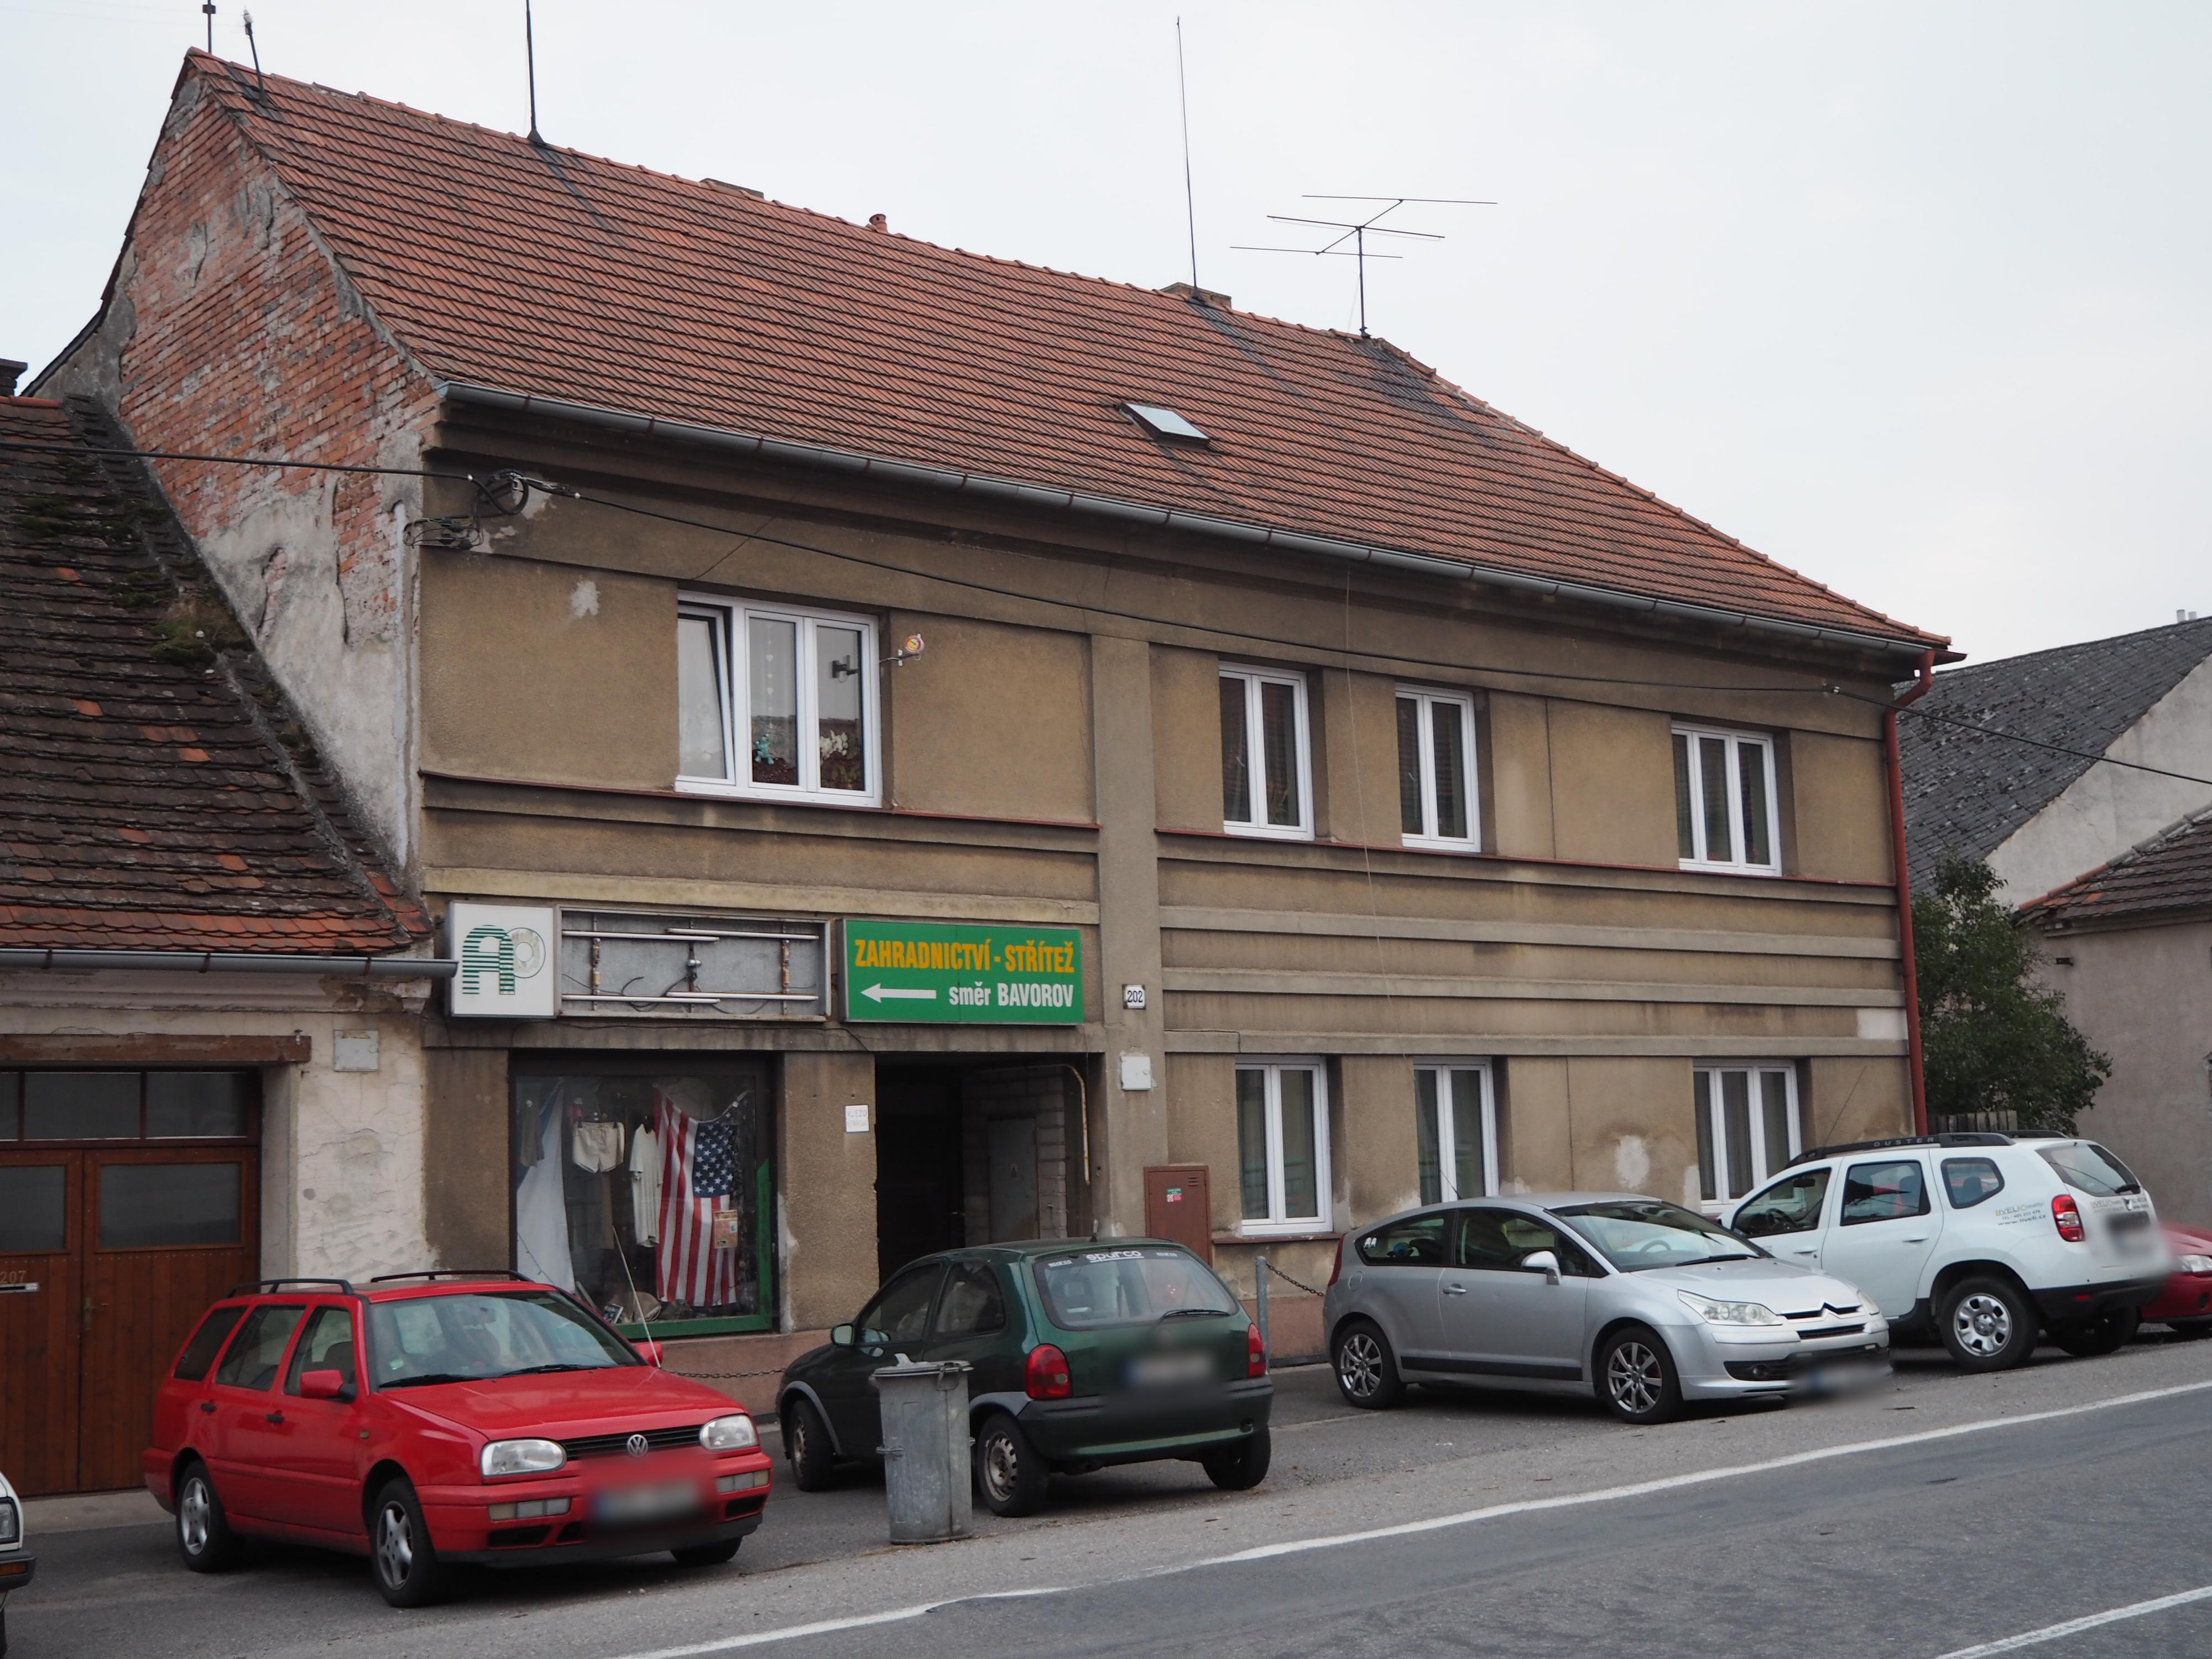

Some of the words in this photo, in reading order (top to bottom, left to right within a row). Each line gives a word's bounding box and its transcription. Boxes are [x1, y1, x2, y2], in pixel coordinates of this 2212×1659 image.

[854, 938, 992, 971] ZAHRADNICTVÍ
[1004, 940, 1075, 973] STŘÍTEŽ
[949, 982, 992, 1006] směr
[998, 983, 1074, 1008] BAVOROV
[1127, 990, 1144, 1003] 202
[1874, 1136, 1934, 1147] DUSTER
[0, 1270, 26, 1284] 207
